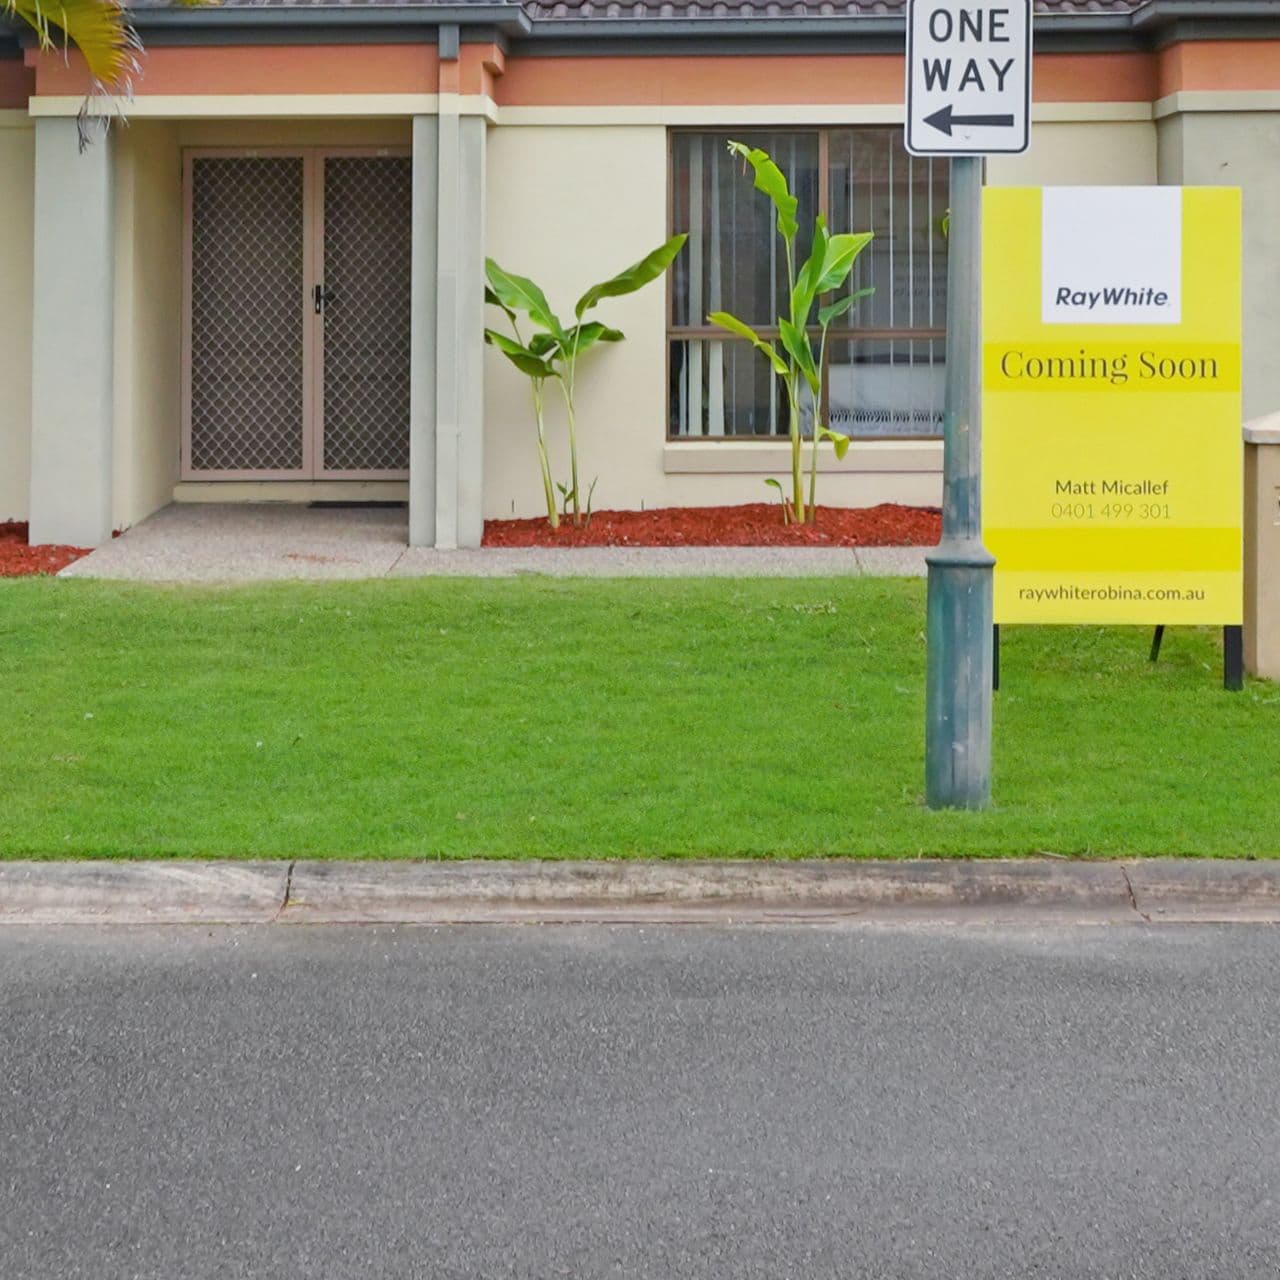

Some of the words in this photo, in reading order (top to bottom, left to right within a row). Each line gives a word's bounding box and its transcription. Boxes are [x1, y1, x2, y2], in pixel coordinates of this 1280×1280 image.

[928, 8, 1010, 43] ONE
[922, 58, 1016, 92] WAY
[1000, 349, 1128, 385] Coming
[1138, 350, 1219, 380] Soon
[1055, 479, 1096, 496] Matt
[1101, 479, 1170, 496] Micallef
[1050, 503, 1095, 520] 0401
[1100, 503, 1134, 520] 499
[1139, 503, 1171, 520] 301
[1018, 585, 1206, 603] raywhiterobina.com.au
